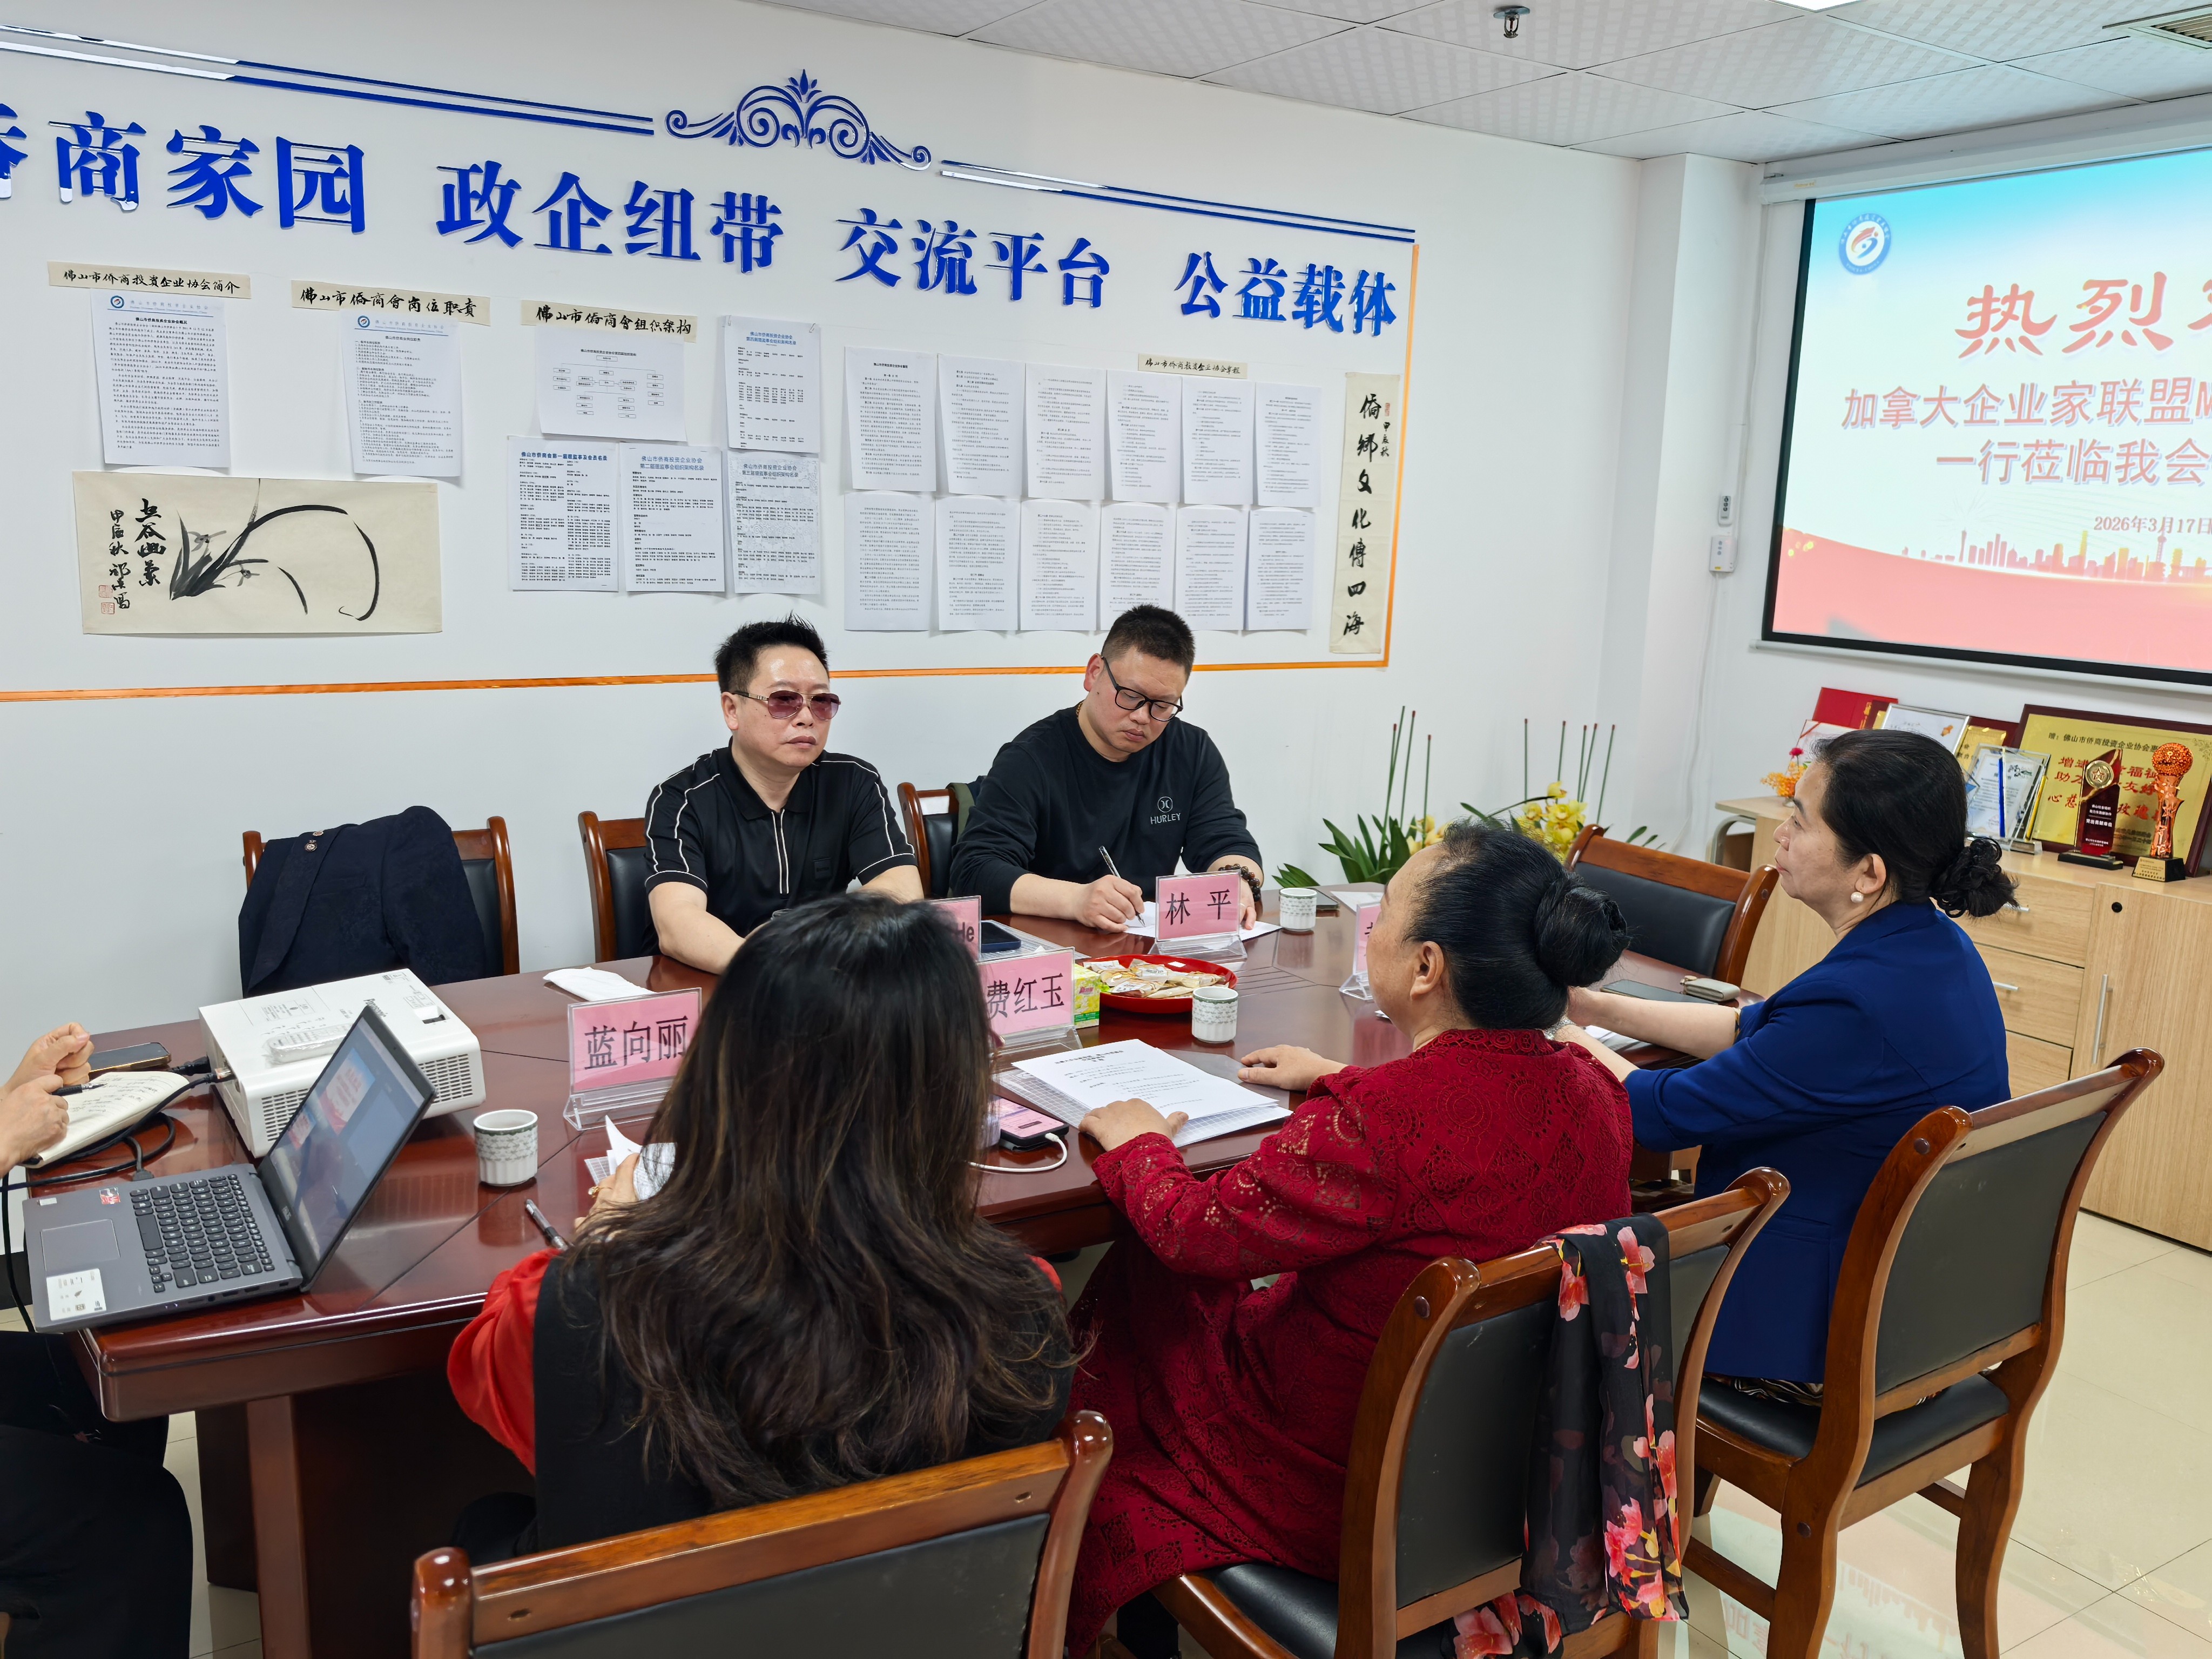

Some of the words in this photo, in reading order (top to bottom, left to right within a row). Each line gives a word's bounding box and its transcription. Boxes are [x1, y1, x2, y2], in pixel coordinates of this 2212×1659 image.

[436, 160, 786, 274] 政企纽带
[834, 207, 1111, 309] 交流平台
[1175, 251, 1398, 338] 公益载体
[1937, 437, 2209, 486] 一行莅临我会
[2093, 515, 2212, 534] 2026年3月17日
[1150, 812, 1181, 825] HURLEY
[1165, 888, 1232, 926] 林平
[987, 972, 1065, 1020] 费红玉
[584, 1015, 689, 1070] 蓝向丽
